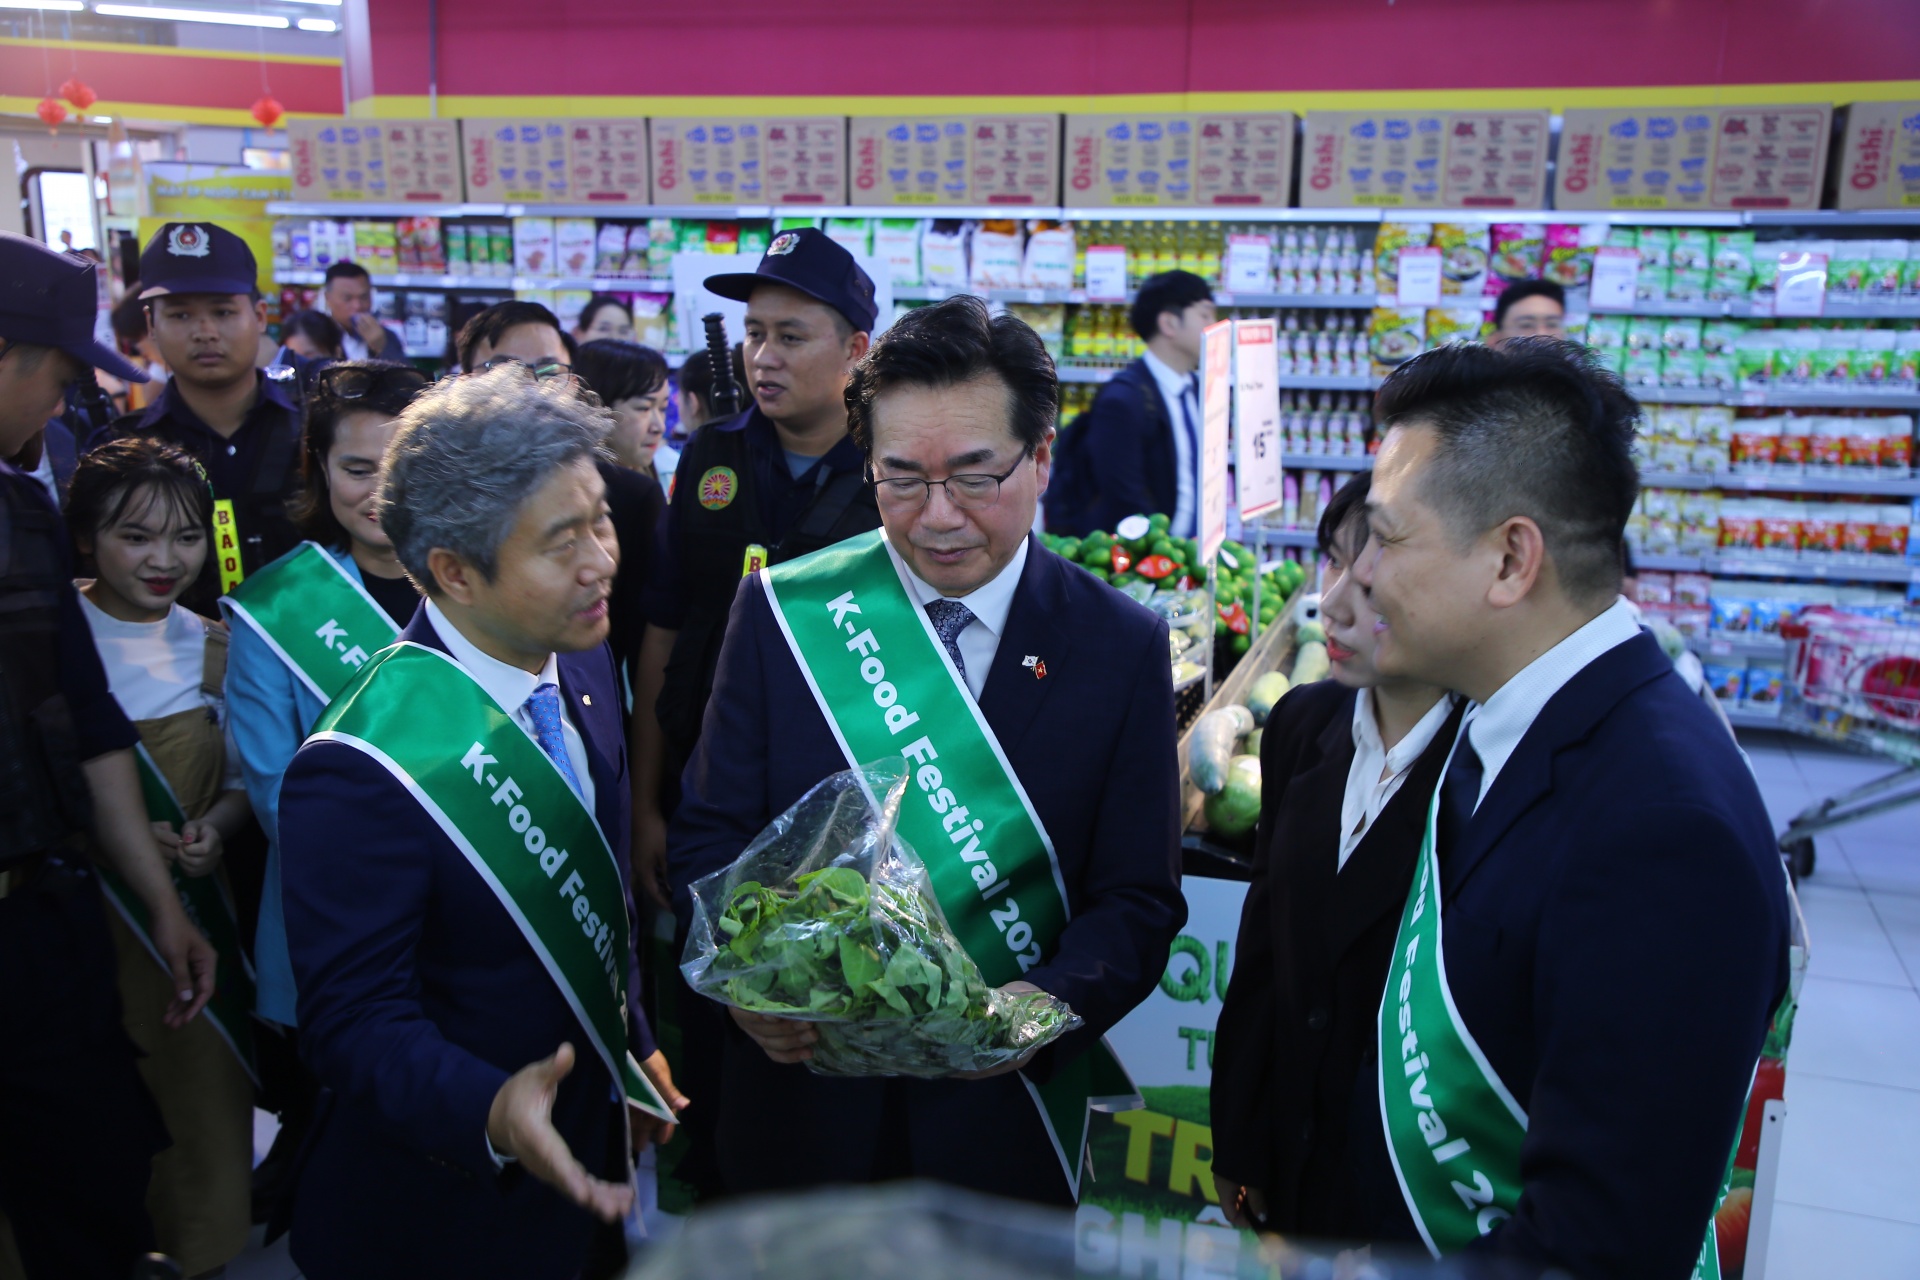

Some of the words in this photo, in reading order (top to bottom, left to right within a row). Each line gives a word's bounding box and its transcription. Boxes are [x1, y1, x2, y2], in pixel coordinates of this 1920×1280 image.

[658, 138, 676, 190] Oishi
[856, 137, 875, 190] Oishi
[1072, 136, 1092, 191] Oishi
[1310, 133, 1337, 191] Oishi
[1564, 133, 1593, 193] Oishi
[1850, 127, 1883, 191] Oishi
[826, 589, 920, 736] K-Food
[901, 735, 1010, 900] Festival
[460, 740, 569, 879] K-Food
[1398, 933, 1472, 1165] Festival
